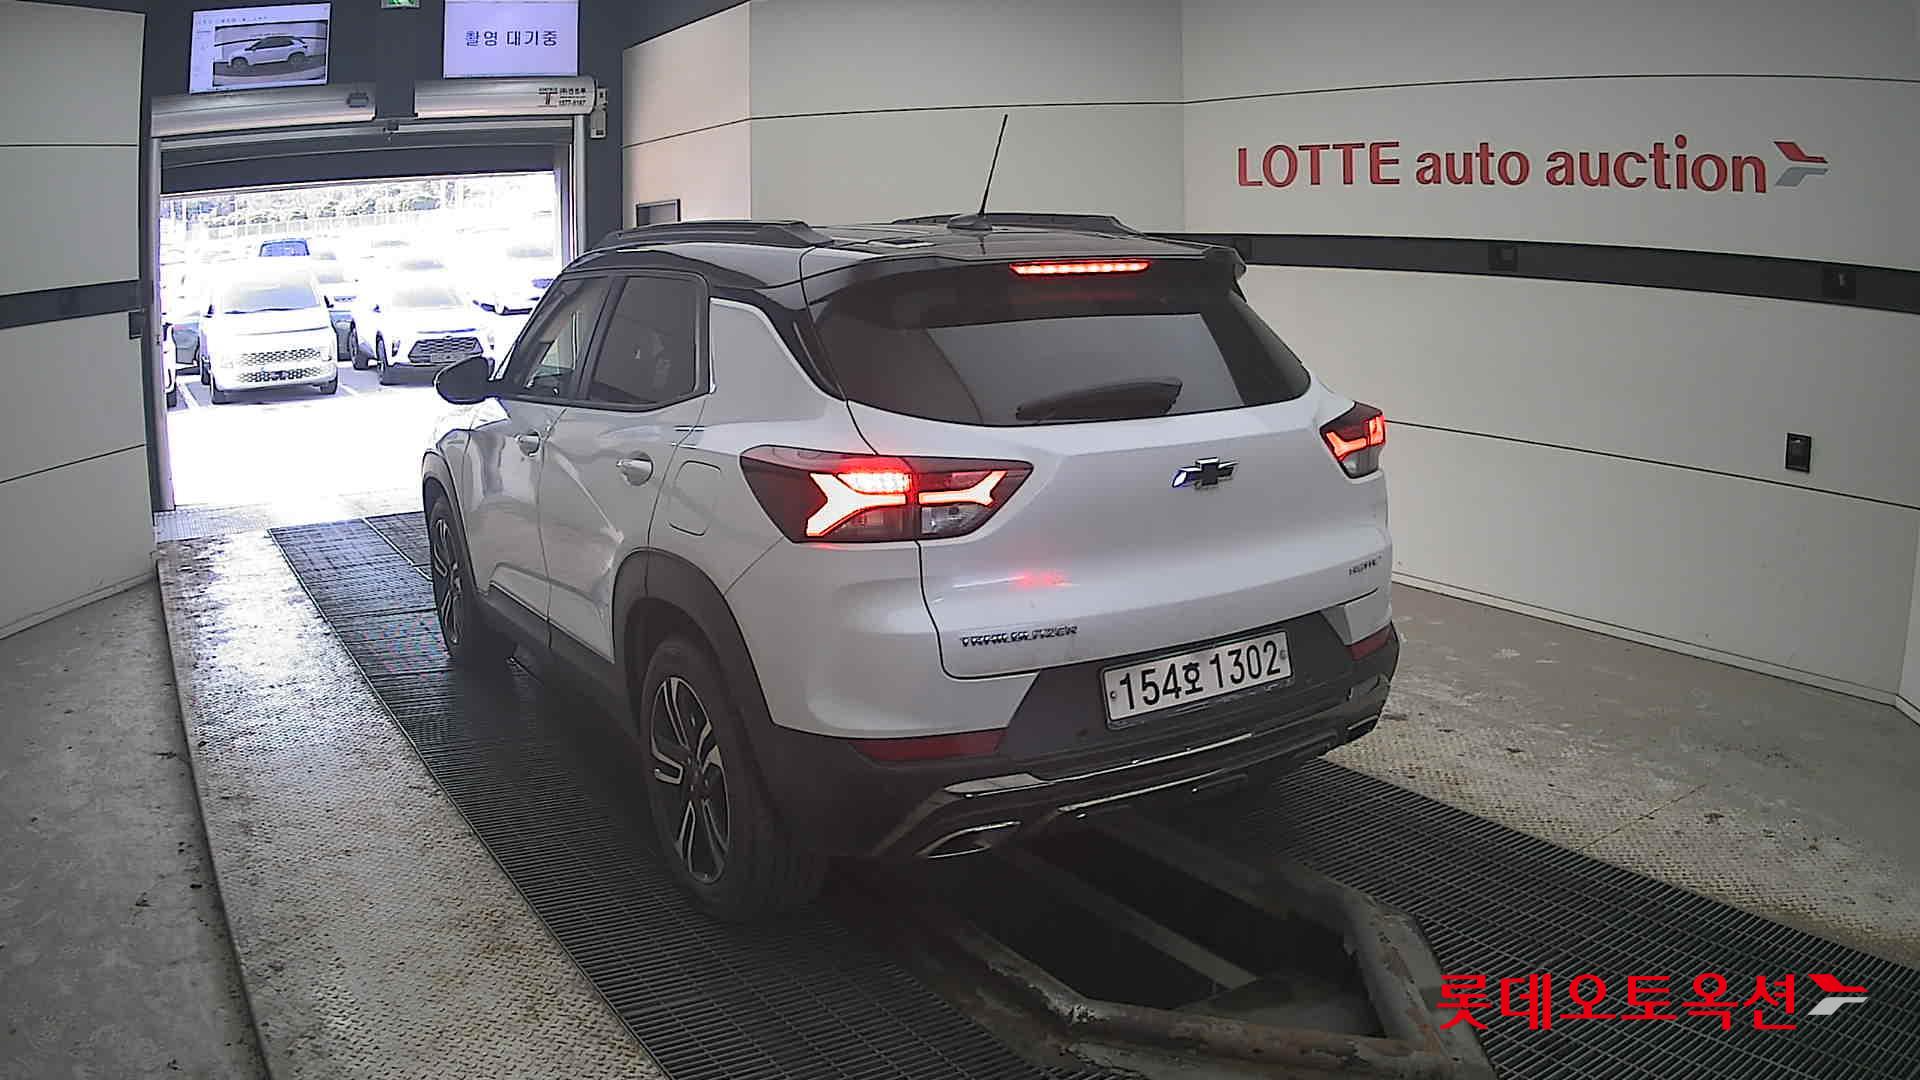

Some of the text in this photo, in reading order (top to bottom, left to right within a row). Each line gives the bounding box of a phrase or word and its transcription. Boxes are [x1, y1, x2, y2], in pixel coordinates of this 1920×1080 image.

[506, 30, 558, 47] 대기중
[1237, 134, 1767, 194] LOTTE auto auction
[1119, 640, 1281, 710] 154호 1302
